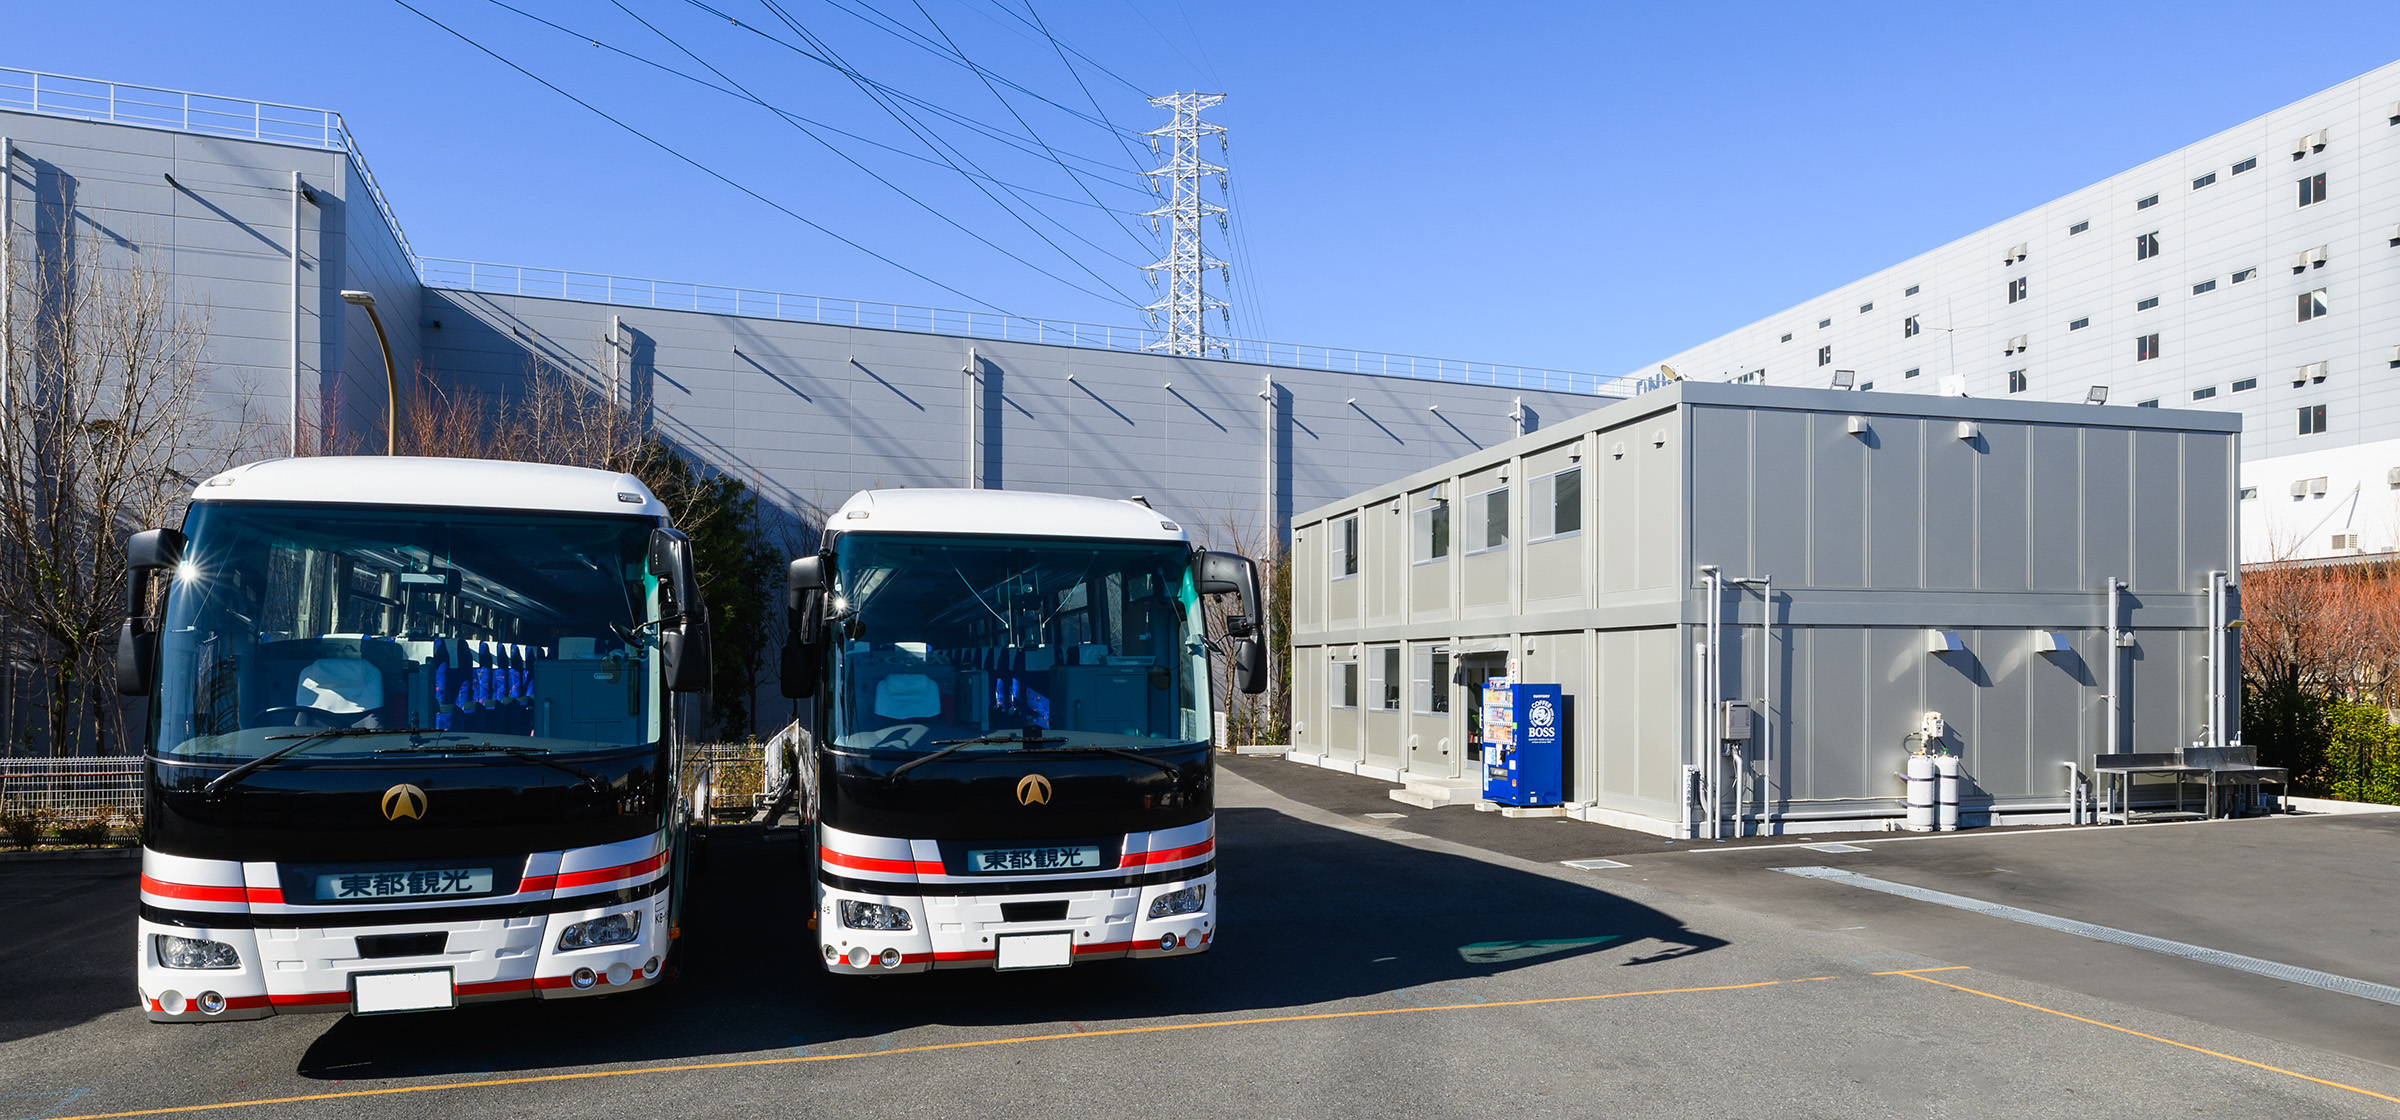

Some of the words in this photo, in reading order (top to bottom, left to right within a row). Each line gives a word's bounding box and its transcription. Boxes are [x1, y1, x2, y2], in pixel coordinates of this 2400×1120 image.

[1531, 700, 1553, 708] COFFEE
[1528, 727, 1555, 738] BOSS
[983, 848, 1083, 870] 東都観光
[338, 869, 473, 898] 東都観光
